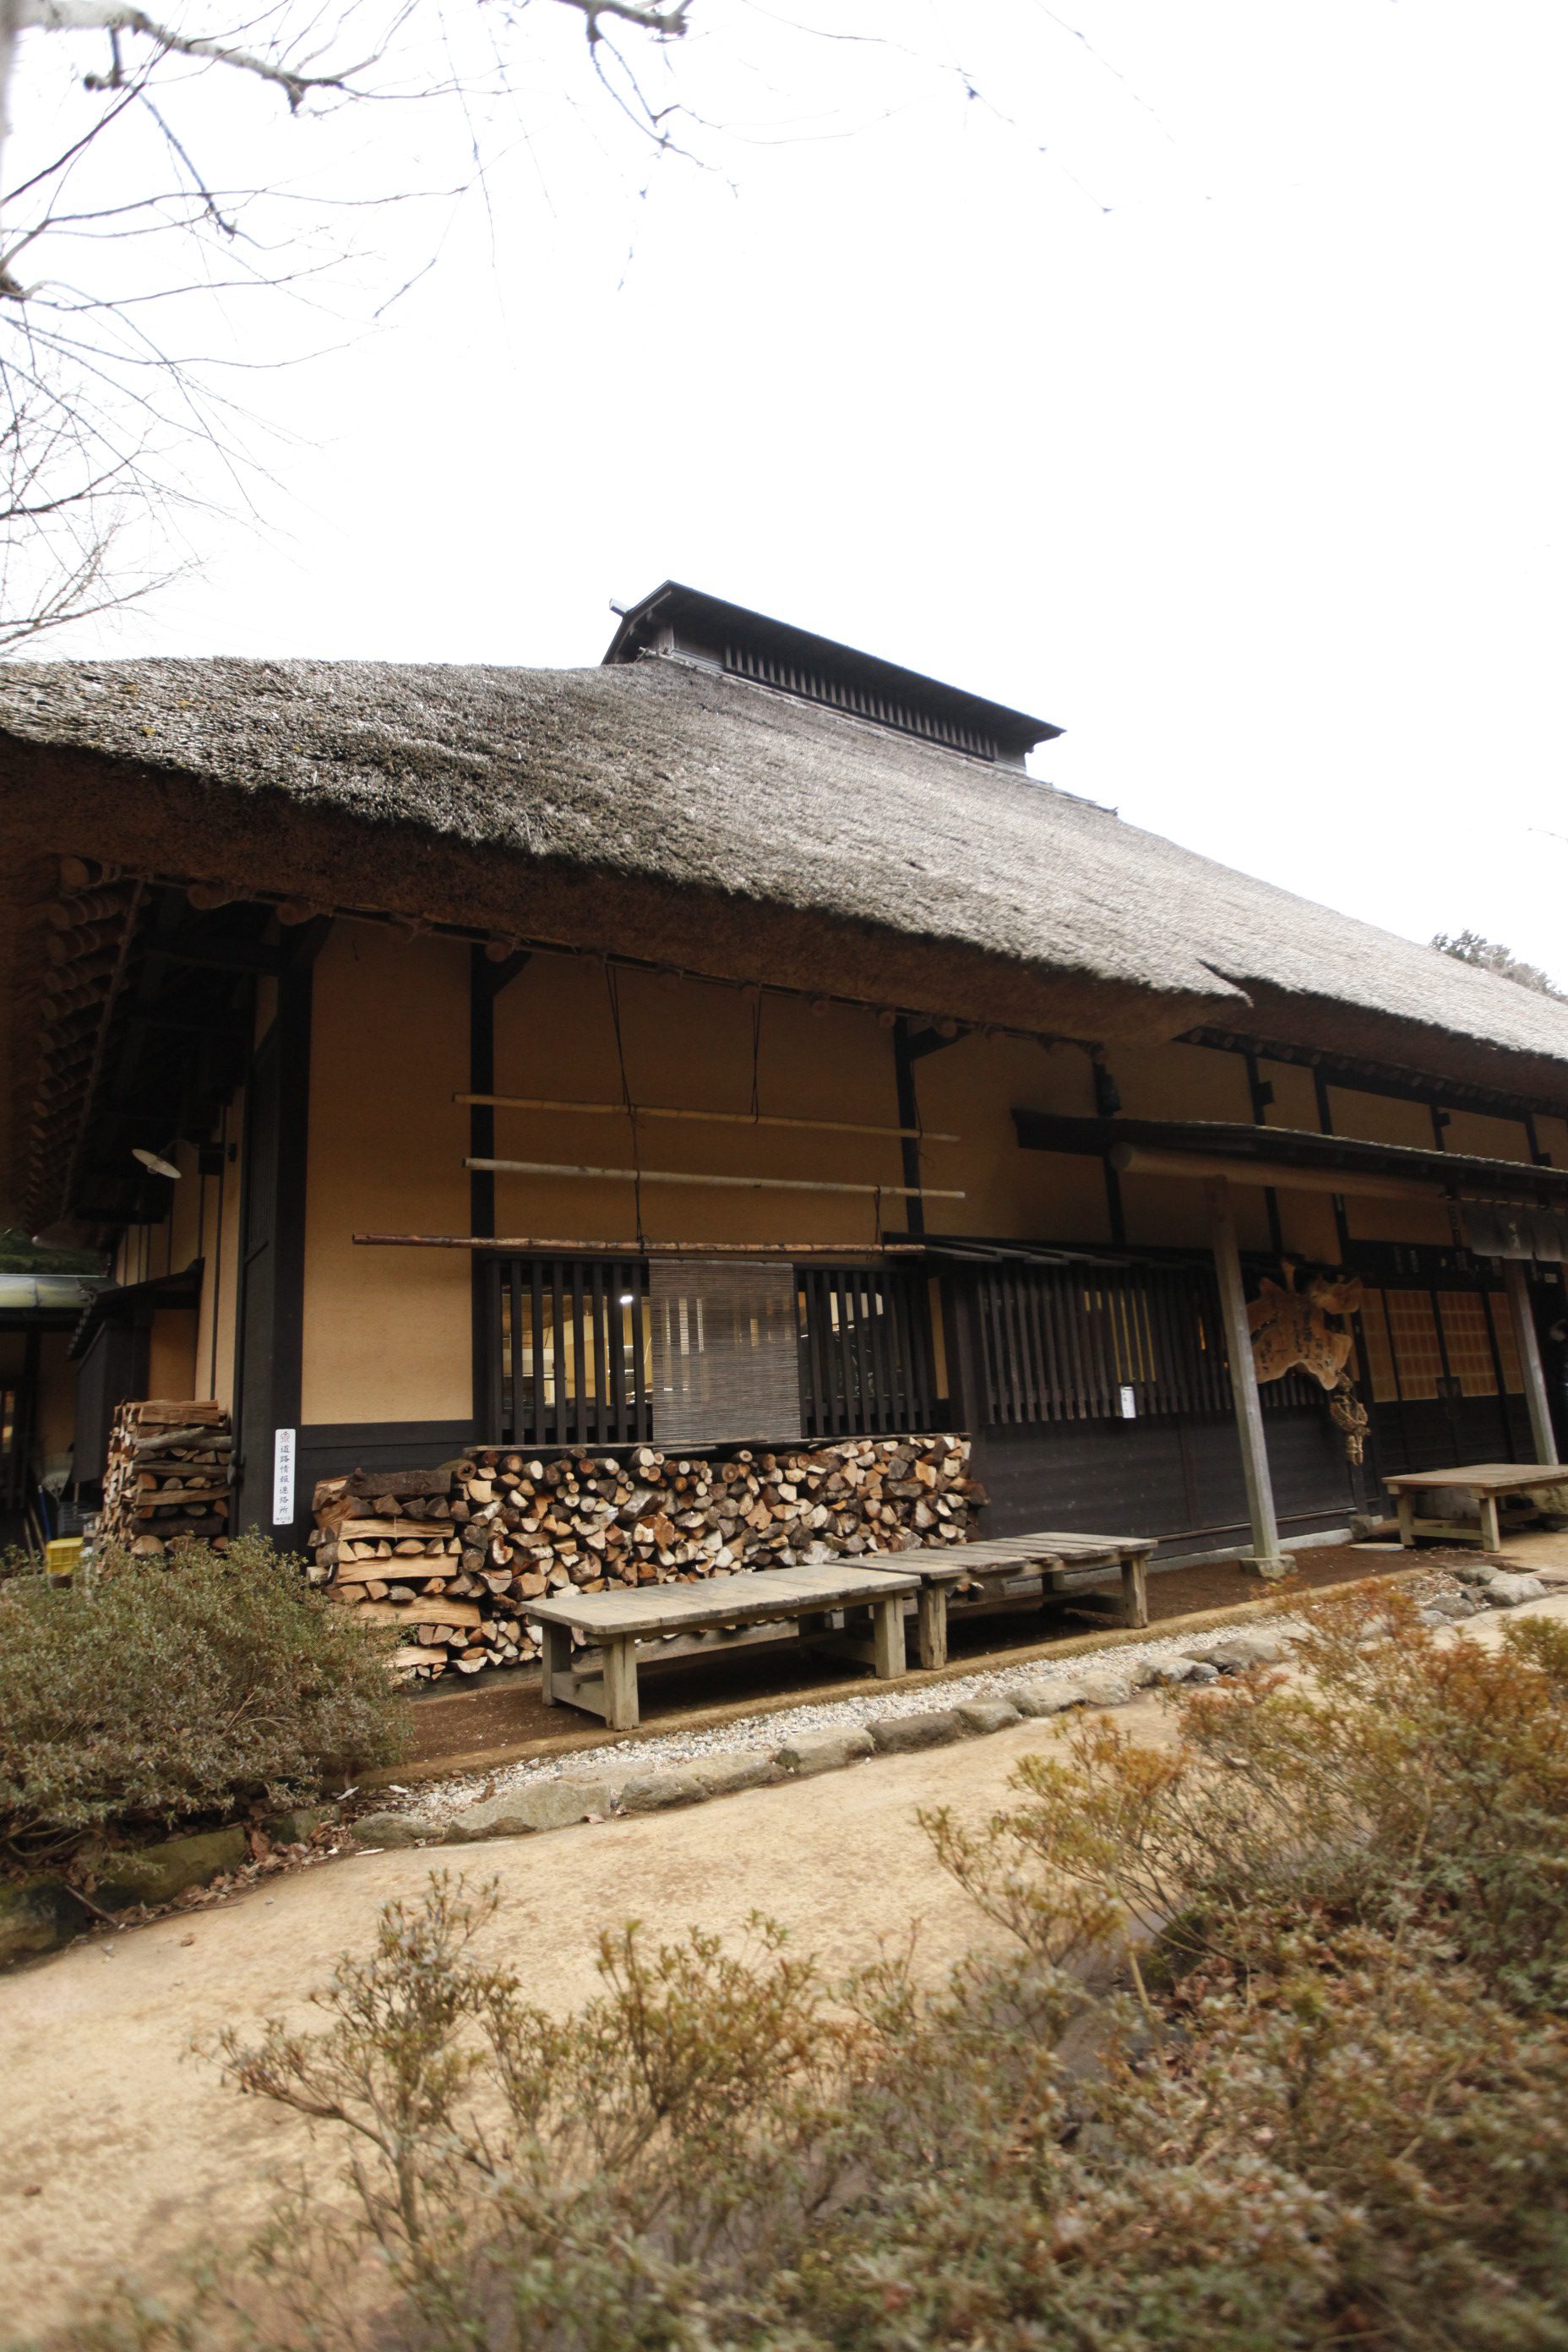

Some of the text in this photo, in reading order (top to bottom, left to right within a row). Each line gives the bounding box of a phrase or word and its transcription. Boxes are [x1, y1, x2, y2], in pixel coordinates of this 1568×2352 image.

[279, 1445, 291, 1515] 道路情報連絡所
